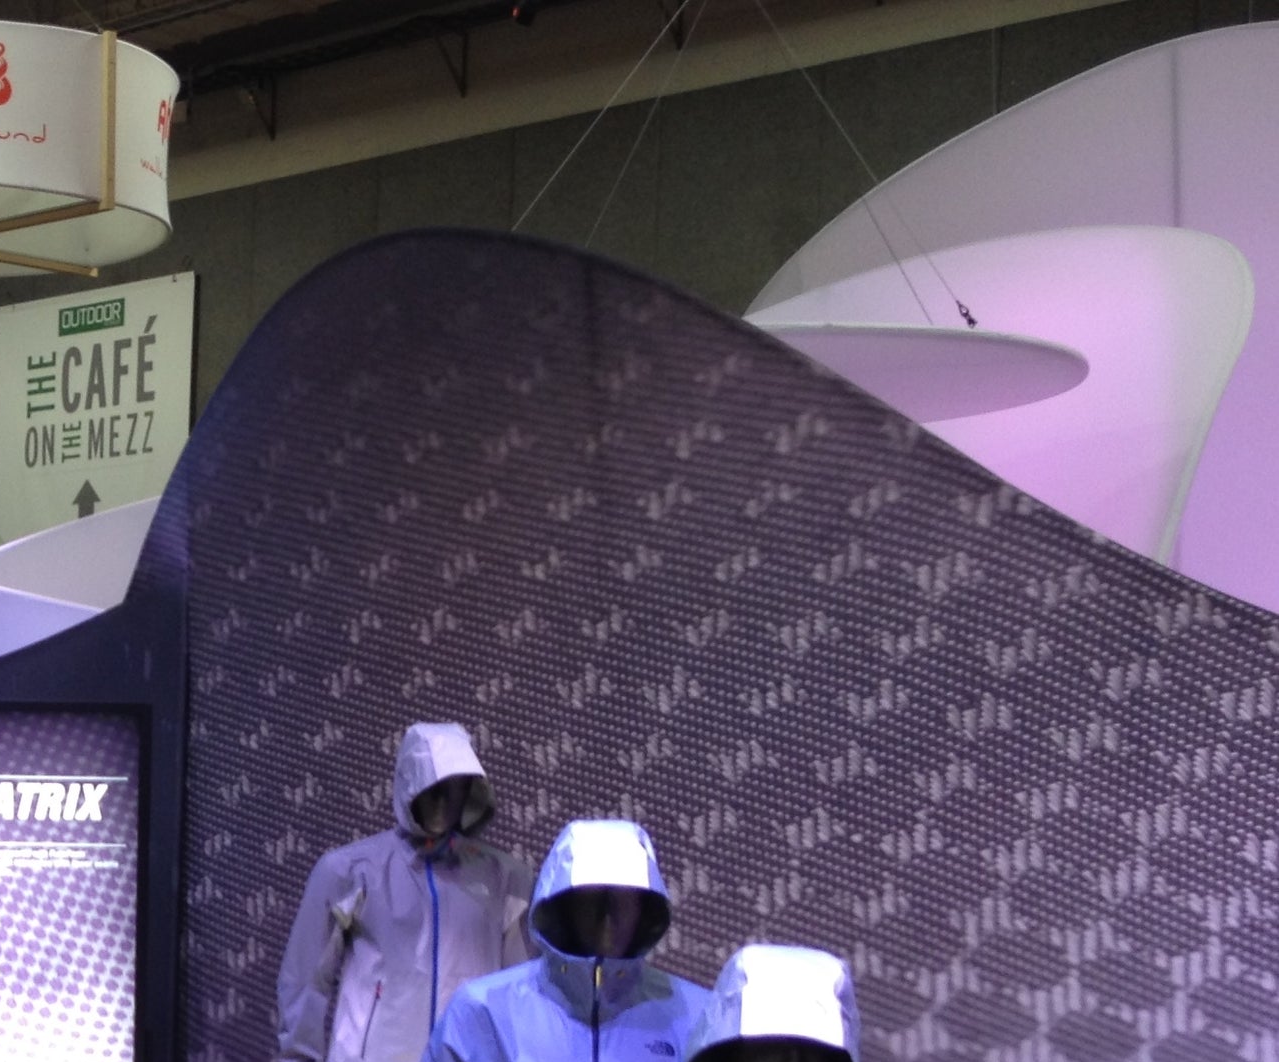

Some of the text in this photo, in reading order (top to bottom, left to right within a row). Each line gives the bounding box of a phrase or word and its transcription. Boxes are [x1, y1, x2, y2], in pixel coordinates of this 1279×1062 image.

[61, 302, 122, 329] OUTDOOR
[27, 351, 56, 418] THE
[61, 315, 157, 413] CAFÉ
[24, 411, 154, 468] ON THE MEZZ
